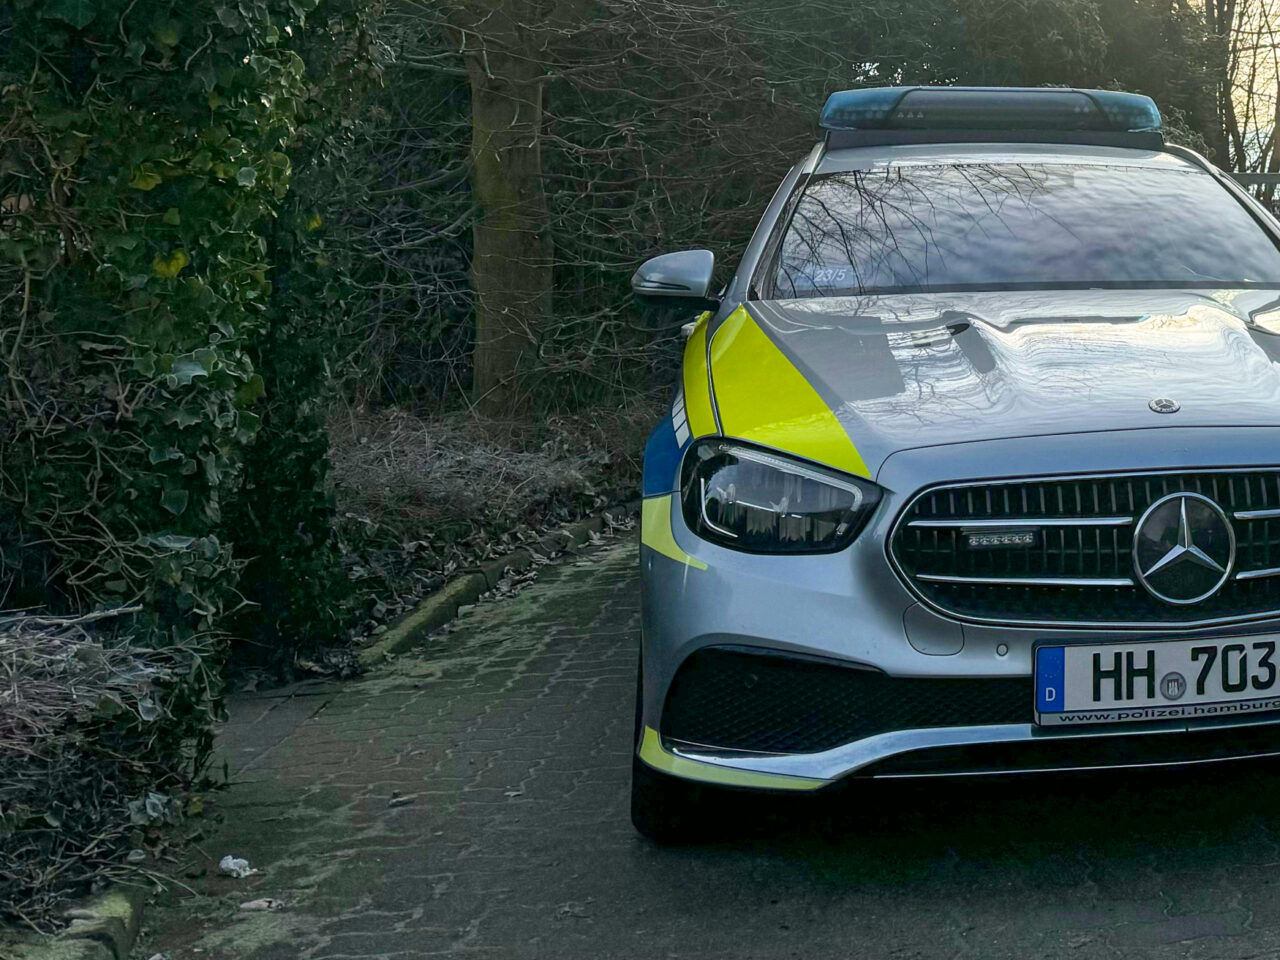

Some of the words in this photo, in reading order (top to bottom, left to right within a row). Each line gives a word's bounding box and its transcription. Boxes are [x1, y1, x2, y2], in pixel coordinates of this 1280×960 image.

[814, 269, 847, 282] 23/5
[1092, 649, 1156, 702] HH
[1045, 687, 1056, 702] D
